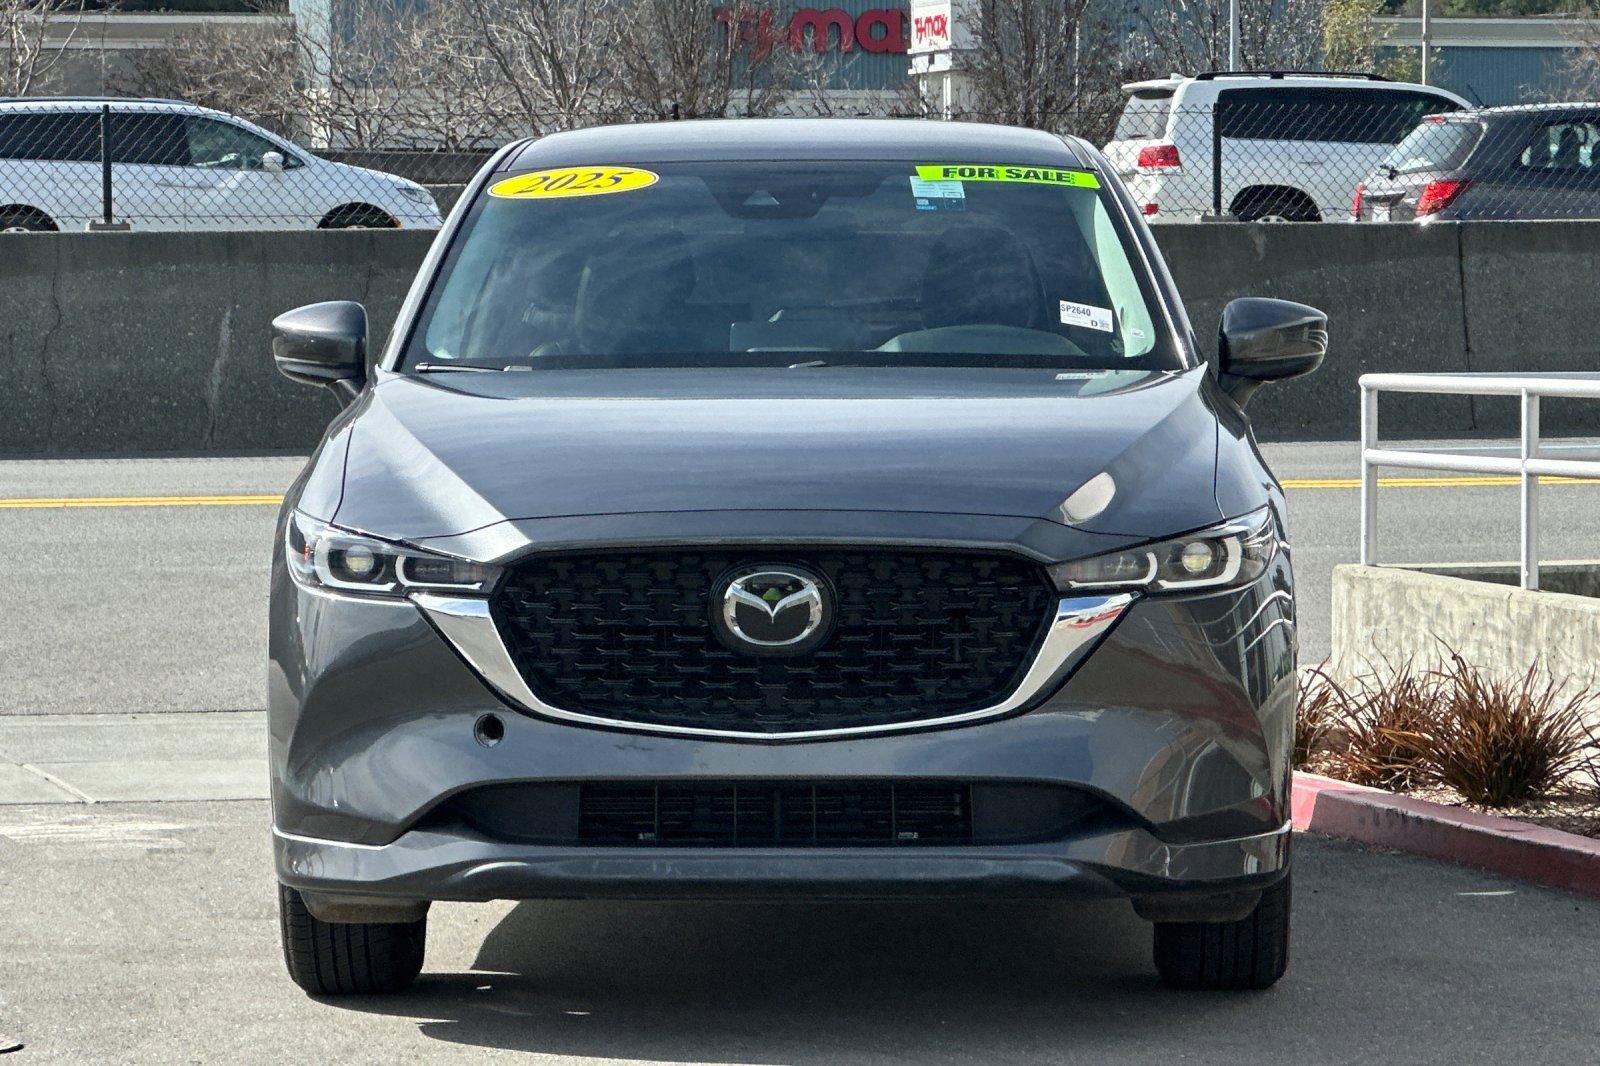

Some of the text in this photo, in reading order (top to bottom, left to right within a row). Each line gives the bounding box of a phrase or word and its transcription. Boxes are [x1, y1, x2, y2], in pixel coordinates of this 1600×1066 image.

[513, 172, 634, 194] 2025
[942, 167, 1072, 183] FOR SALE
[1060, 303, 1091, 317] SP2640
